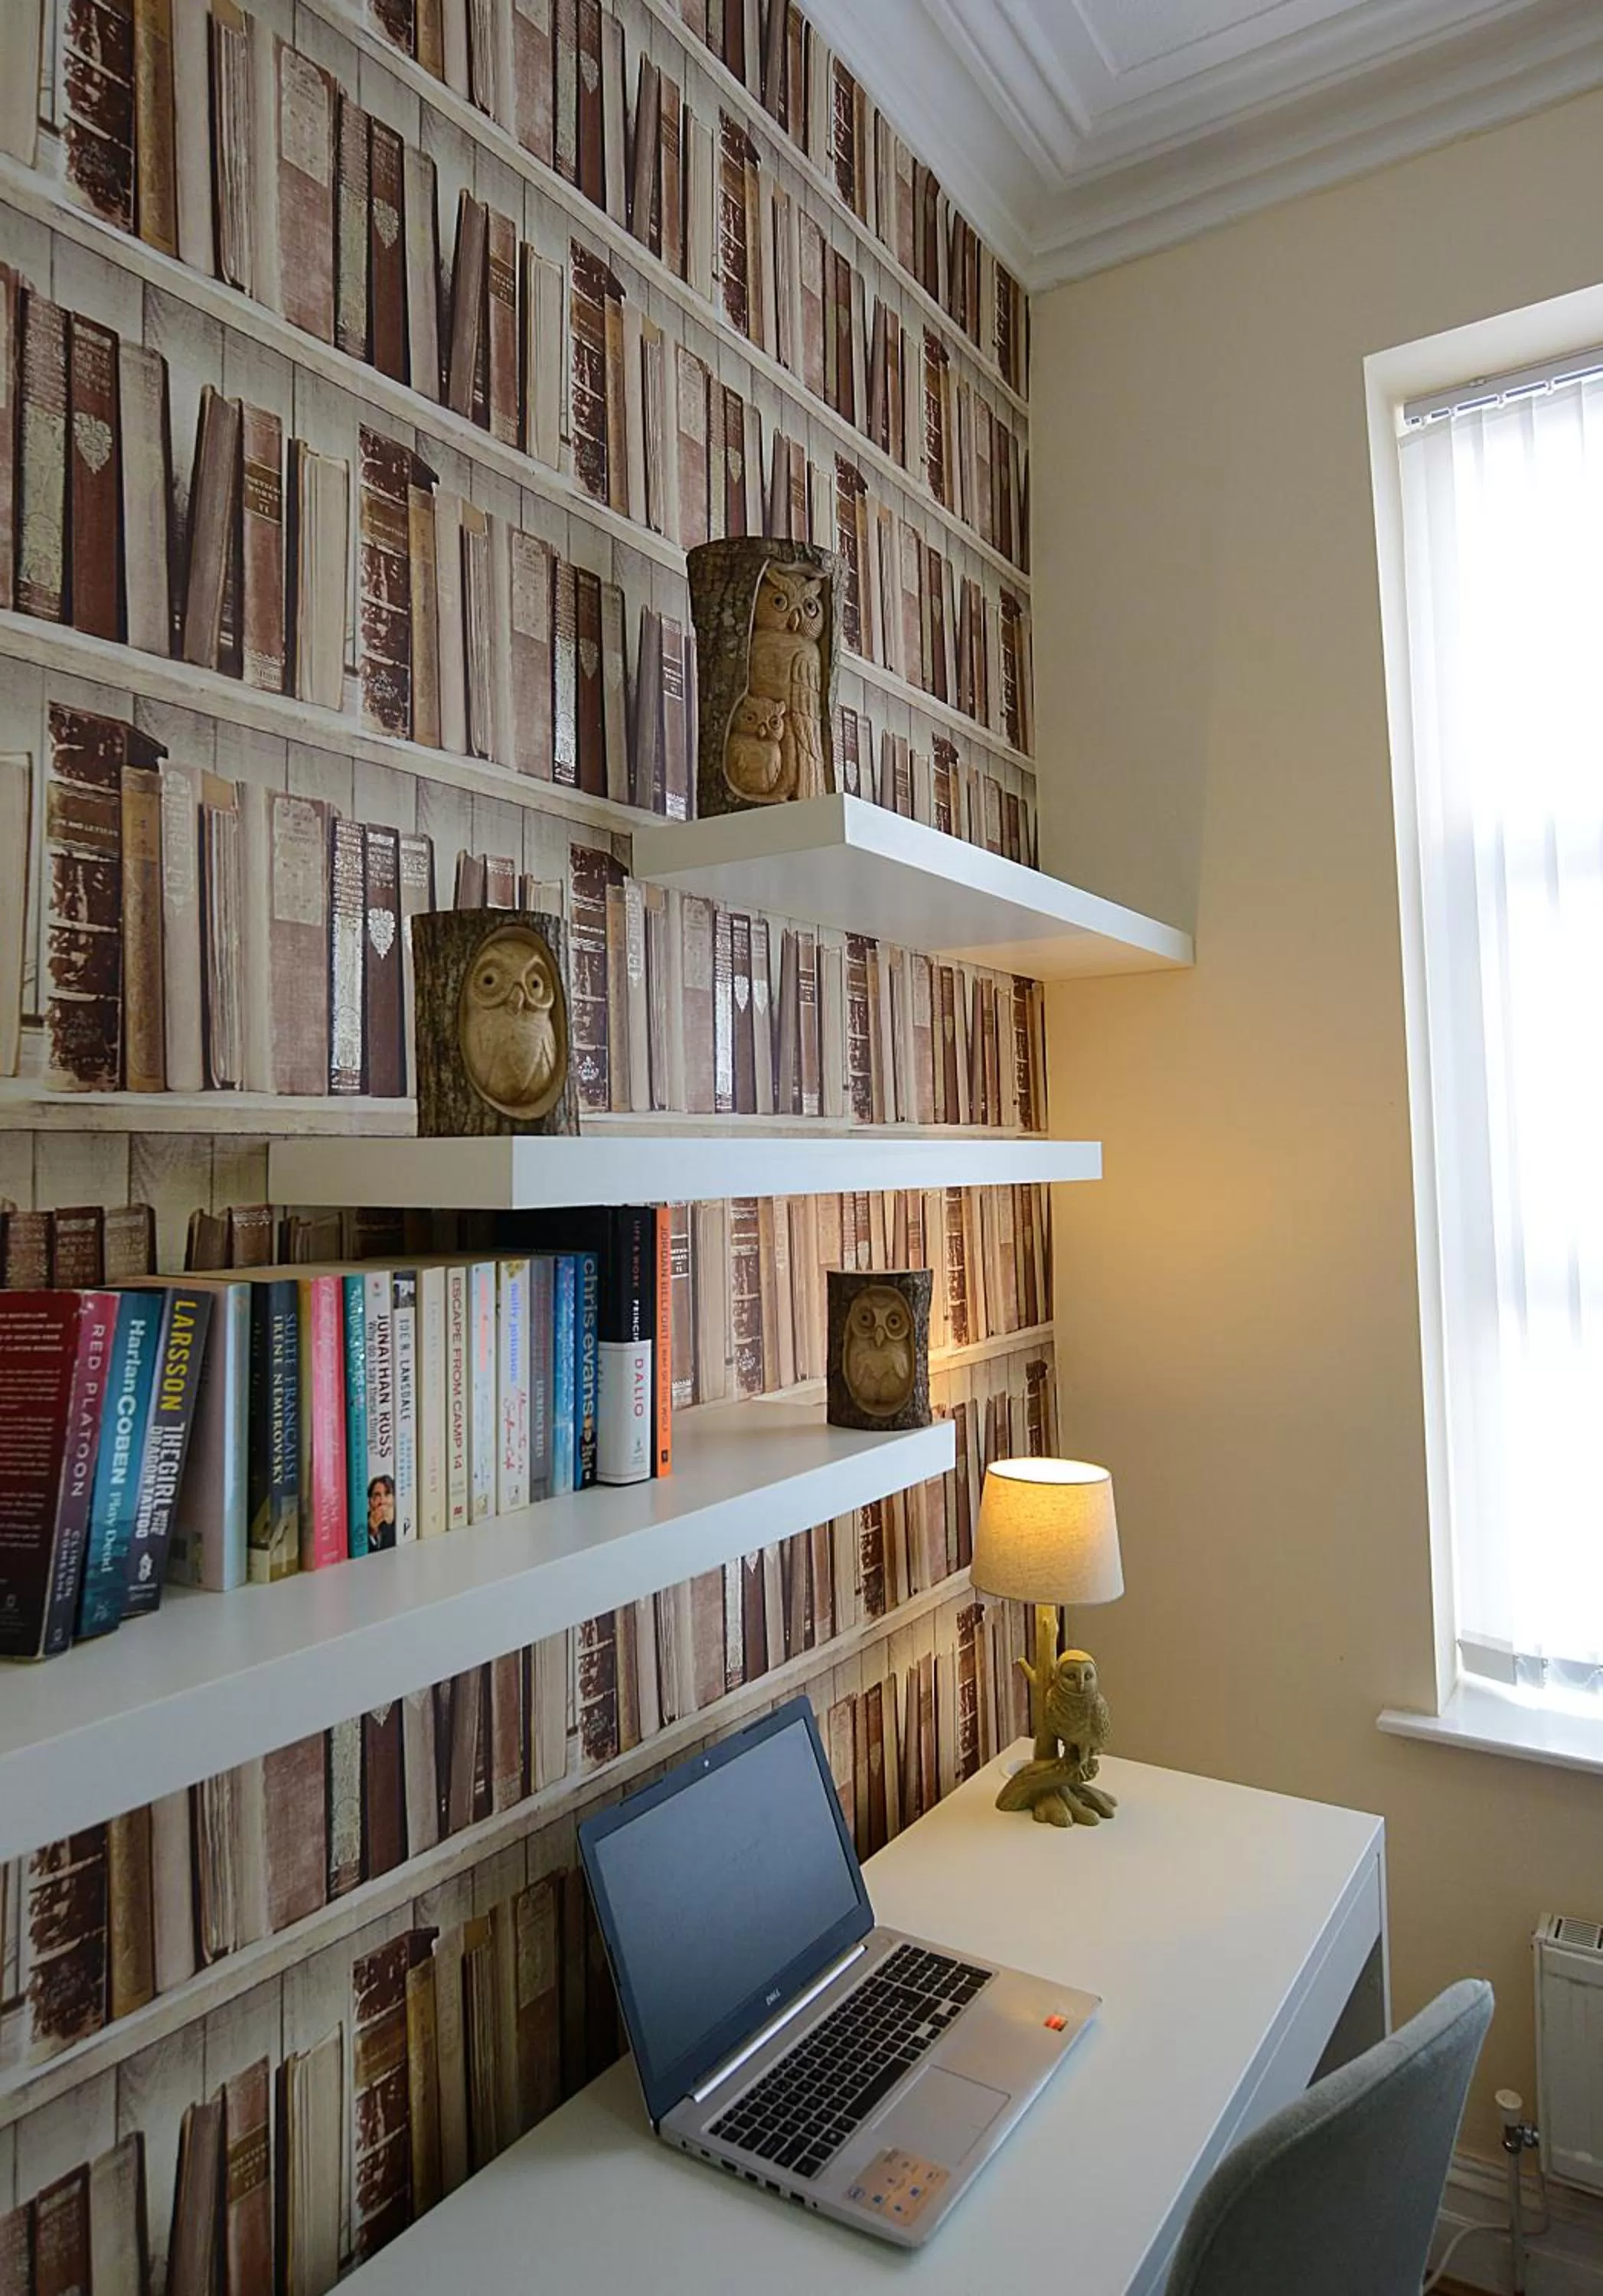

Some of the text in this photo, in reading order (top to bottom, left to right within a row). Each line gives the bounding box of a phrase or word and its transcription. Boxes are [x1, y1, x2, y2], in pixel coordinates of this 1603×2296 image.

[452, 1277, 462, 1345] ESCAPE
[661, 1225, 670, 1339] JORDAN BELFORT
[159, 1300, 197, 1411] LARSSON
[283, 1313, 297, 1367] SUITE
[367, 1322, 377, 1342] Why
[368, 1345, 377, 1357] do
[583, 1257, 599, 1416] chris evans
[110, 1319, 145, 1484] Harlan COBEN
[367, 1367, 377, 1384] say
[368, 1386, 378, 1414] these
[378, 1314, 393, 1459] JONATHAN ROSS
[399, 1360, 410, 1421] LANSDALE
[452, 1348, 462, 1396] FROM
[634, 1358, 645, 1417] DALIO
[70, 1324, 106, 1497] RED PLATOON
[452, 1401, 462, 1448] CAMP
[135, 1425, 165, 1540] DRAGON TATTOO
[452, 1454, 463, 1470] 14
[64, 1531, 81, 1597] CLINTON
[100, 1529, 117, 1574] Dead
